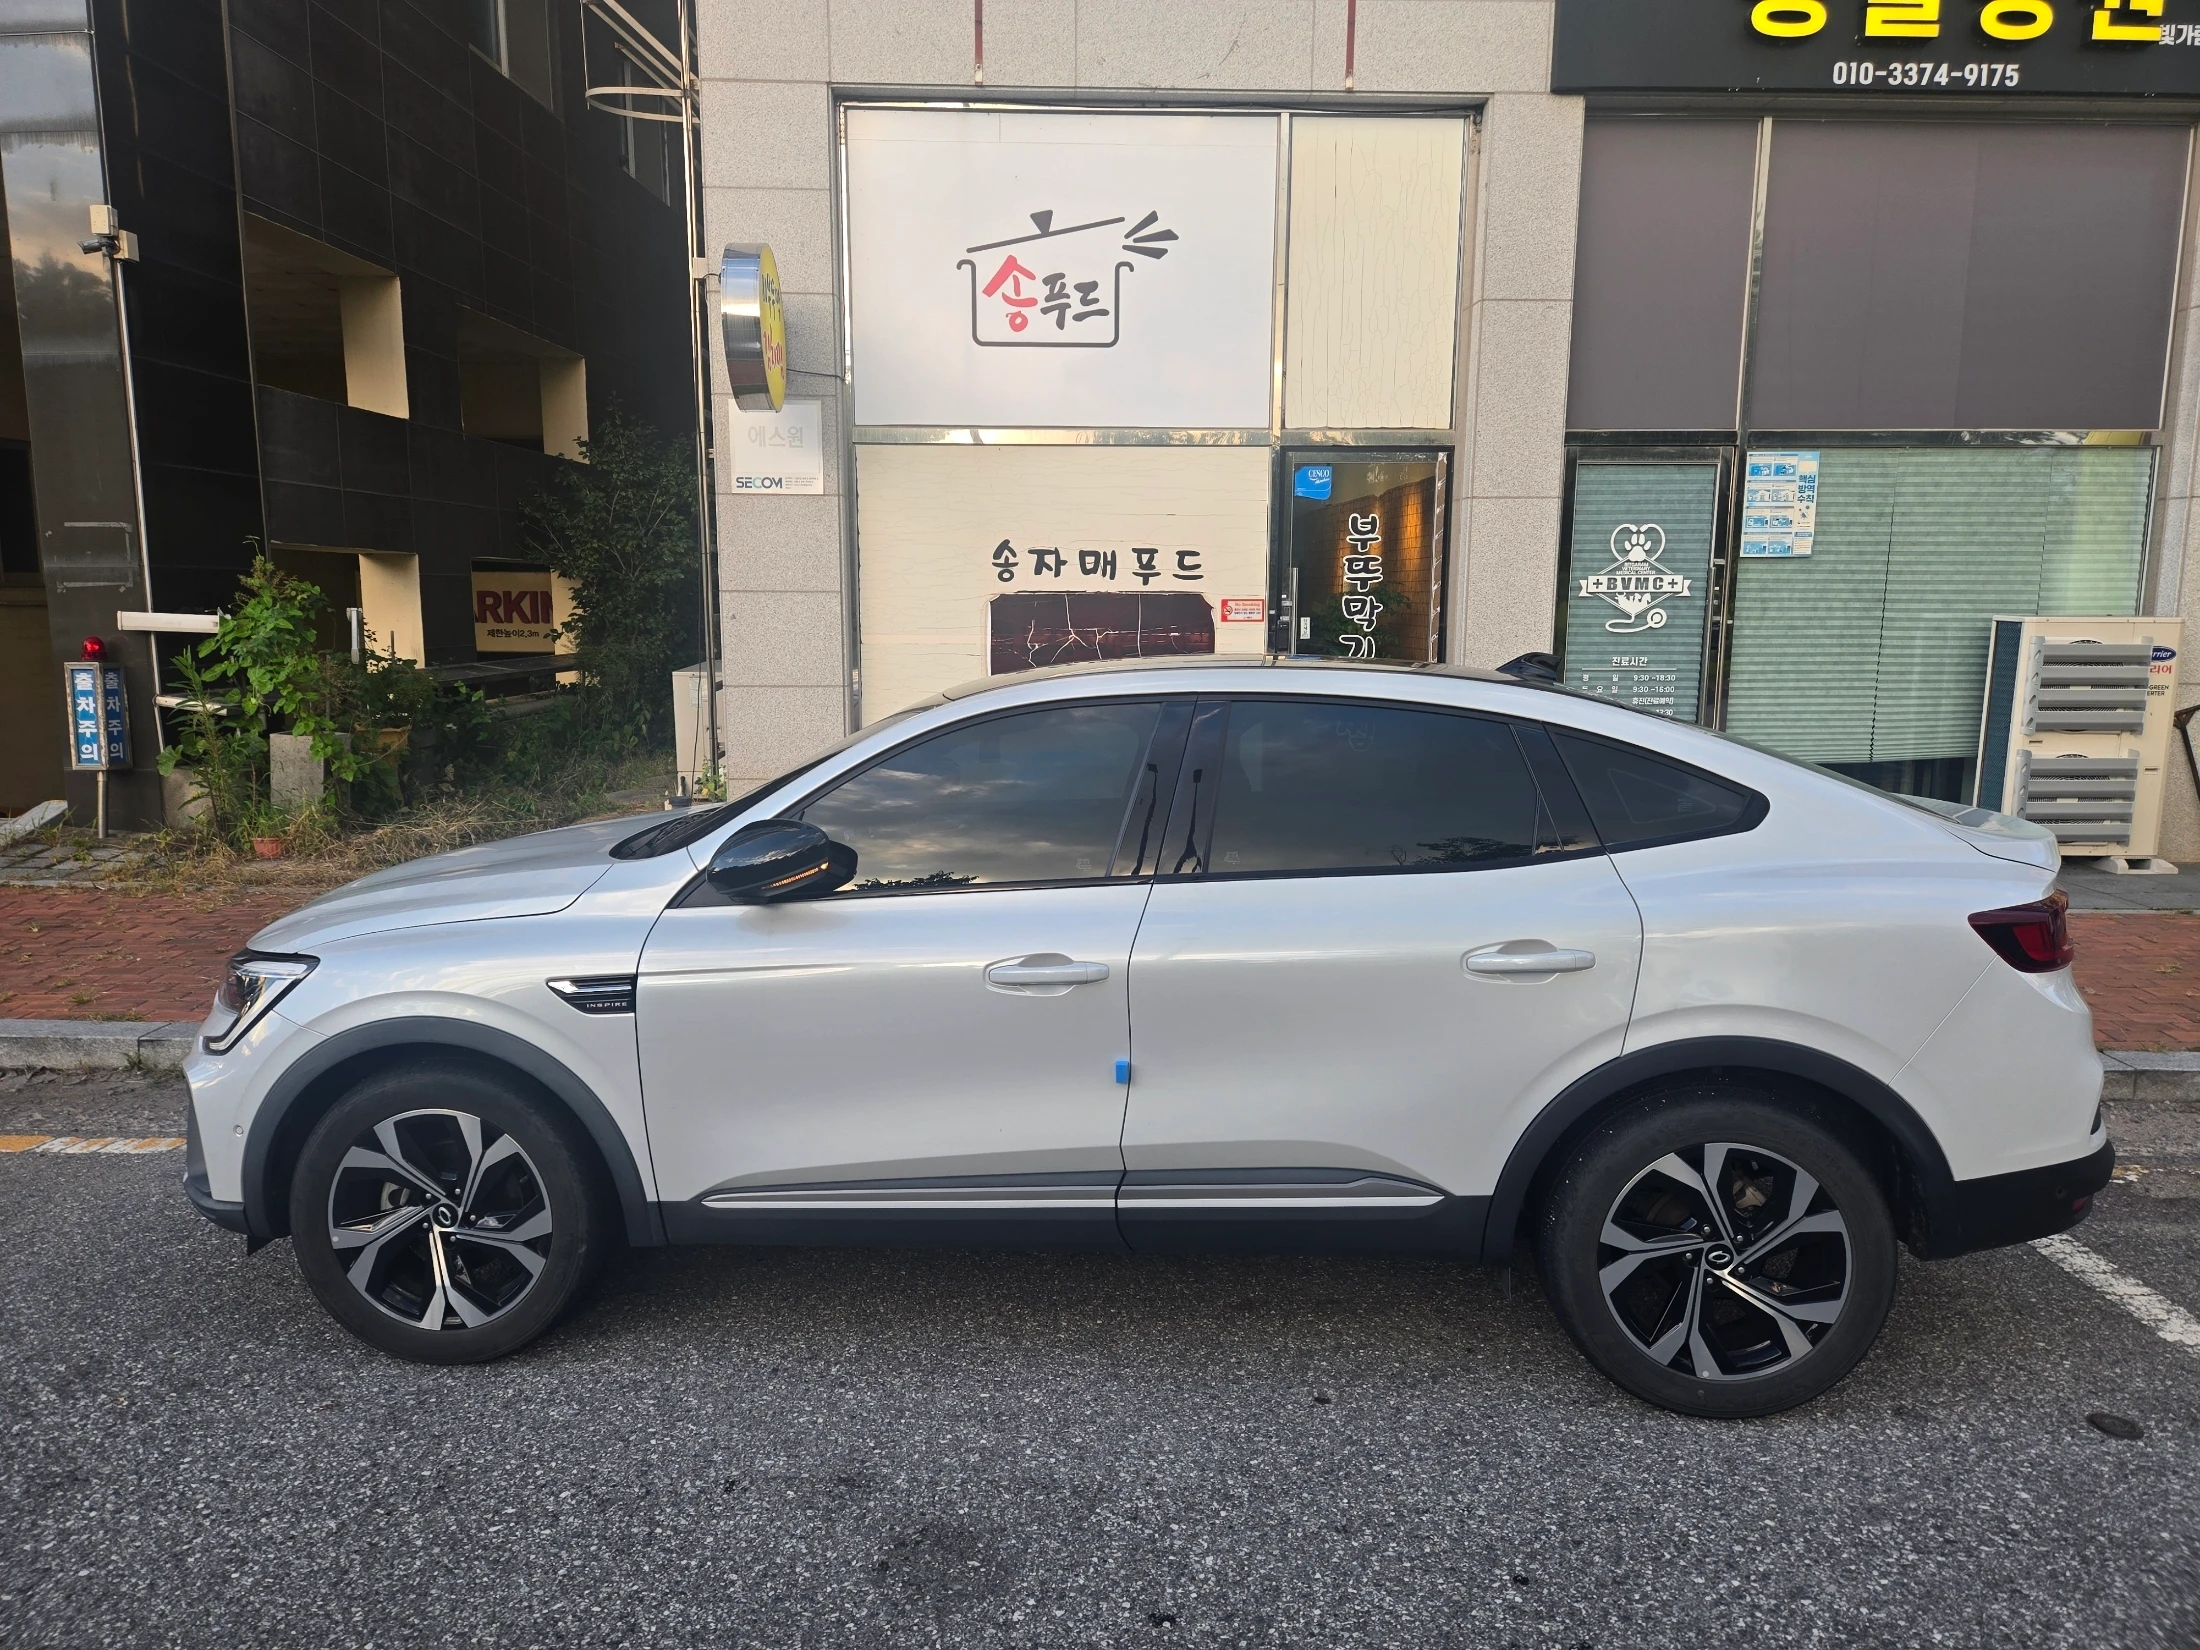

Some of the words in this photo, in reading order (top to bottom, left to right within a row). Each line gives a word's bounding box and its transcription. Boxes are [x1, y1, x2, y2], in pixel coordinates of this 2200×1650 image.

[1832, 61, 2020, 87] 010-3374-9175
[982, 254, 1110, 333] 송푸드
[747, 425, 804, 448] 에스원
[1308, 469, 1330, 478] CESCO
[1798, 474, 1816, 484] 핵심
[736, 476, 783, 489] SECOM
[1797, 484, 1815, 494] 방역
[1797, 494, 1814, 503] 수칙
[991, 538, 1205, 586] 송자매푸드
[1606, 576, 1665, 590] BVMC
[474, 590, 553, 624] RKI
[2151, 650, 2172, 658] rrier
[1611, 656, 1648, 667] 진료시간
[2149, 664, 2172, 674] 리어
[74, 672, 99, 761] 출차주의
[104, 672, 124, 759] 출차주의
